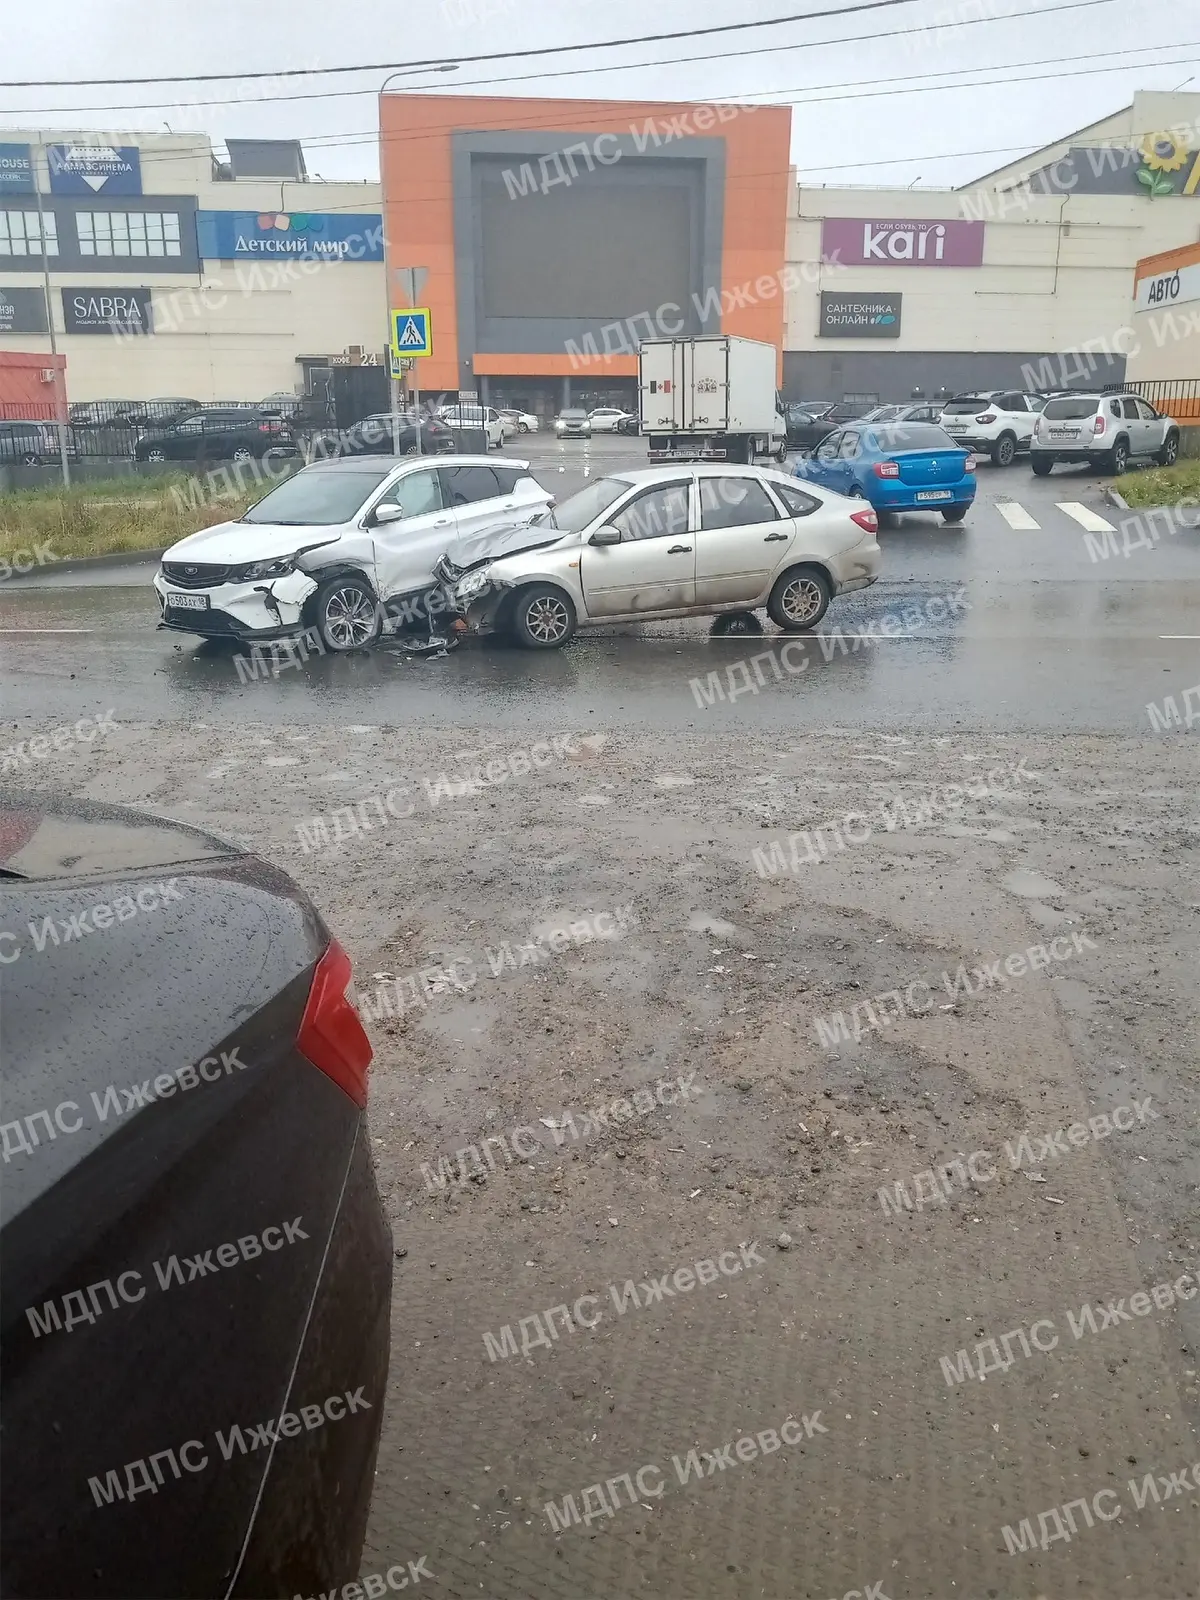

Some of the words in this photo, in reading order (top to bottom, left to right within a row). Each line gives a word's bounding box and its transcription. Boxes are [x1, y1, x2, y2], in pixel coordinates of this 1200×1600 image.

[56, 162, 133, 172] АЛМАЗСИНЕМА
[235, 235, 307, 252] Детский
[313, 240, 349, 258] мир
[863, 223, 946, 260] kari
[73, 296, 141, 318] SABRA
[826, 314, 868, 325] ОНЛАЙН
[360, 353, 378, 366] 24
